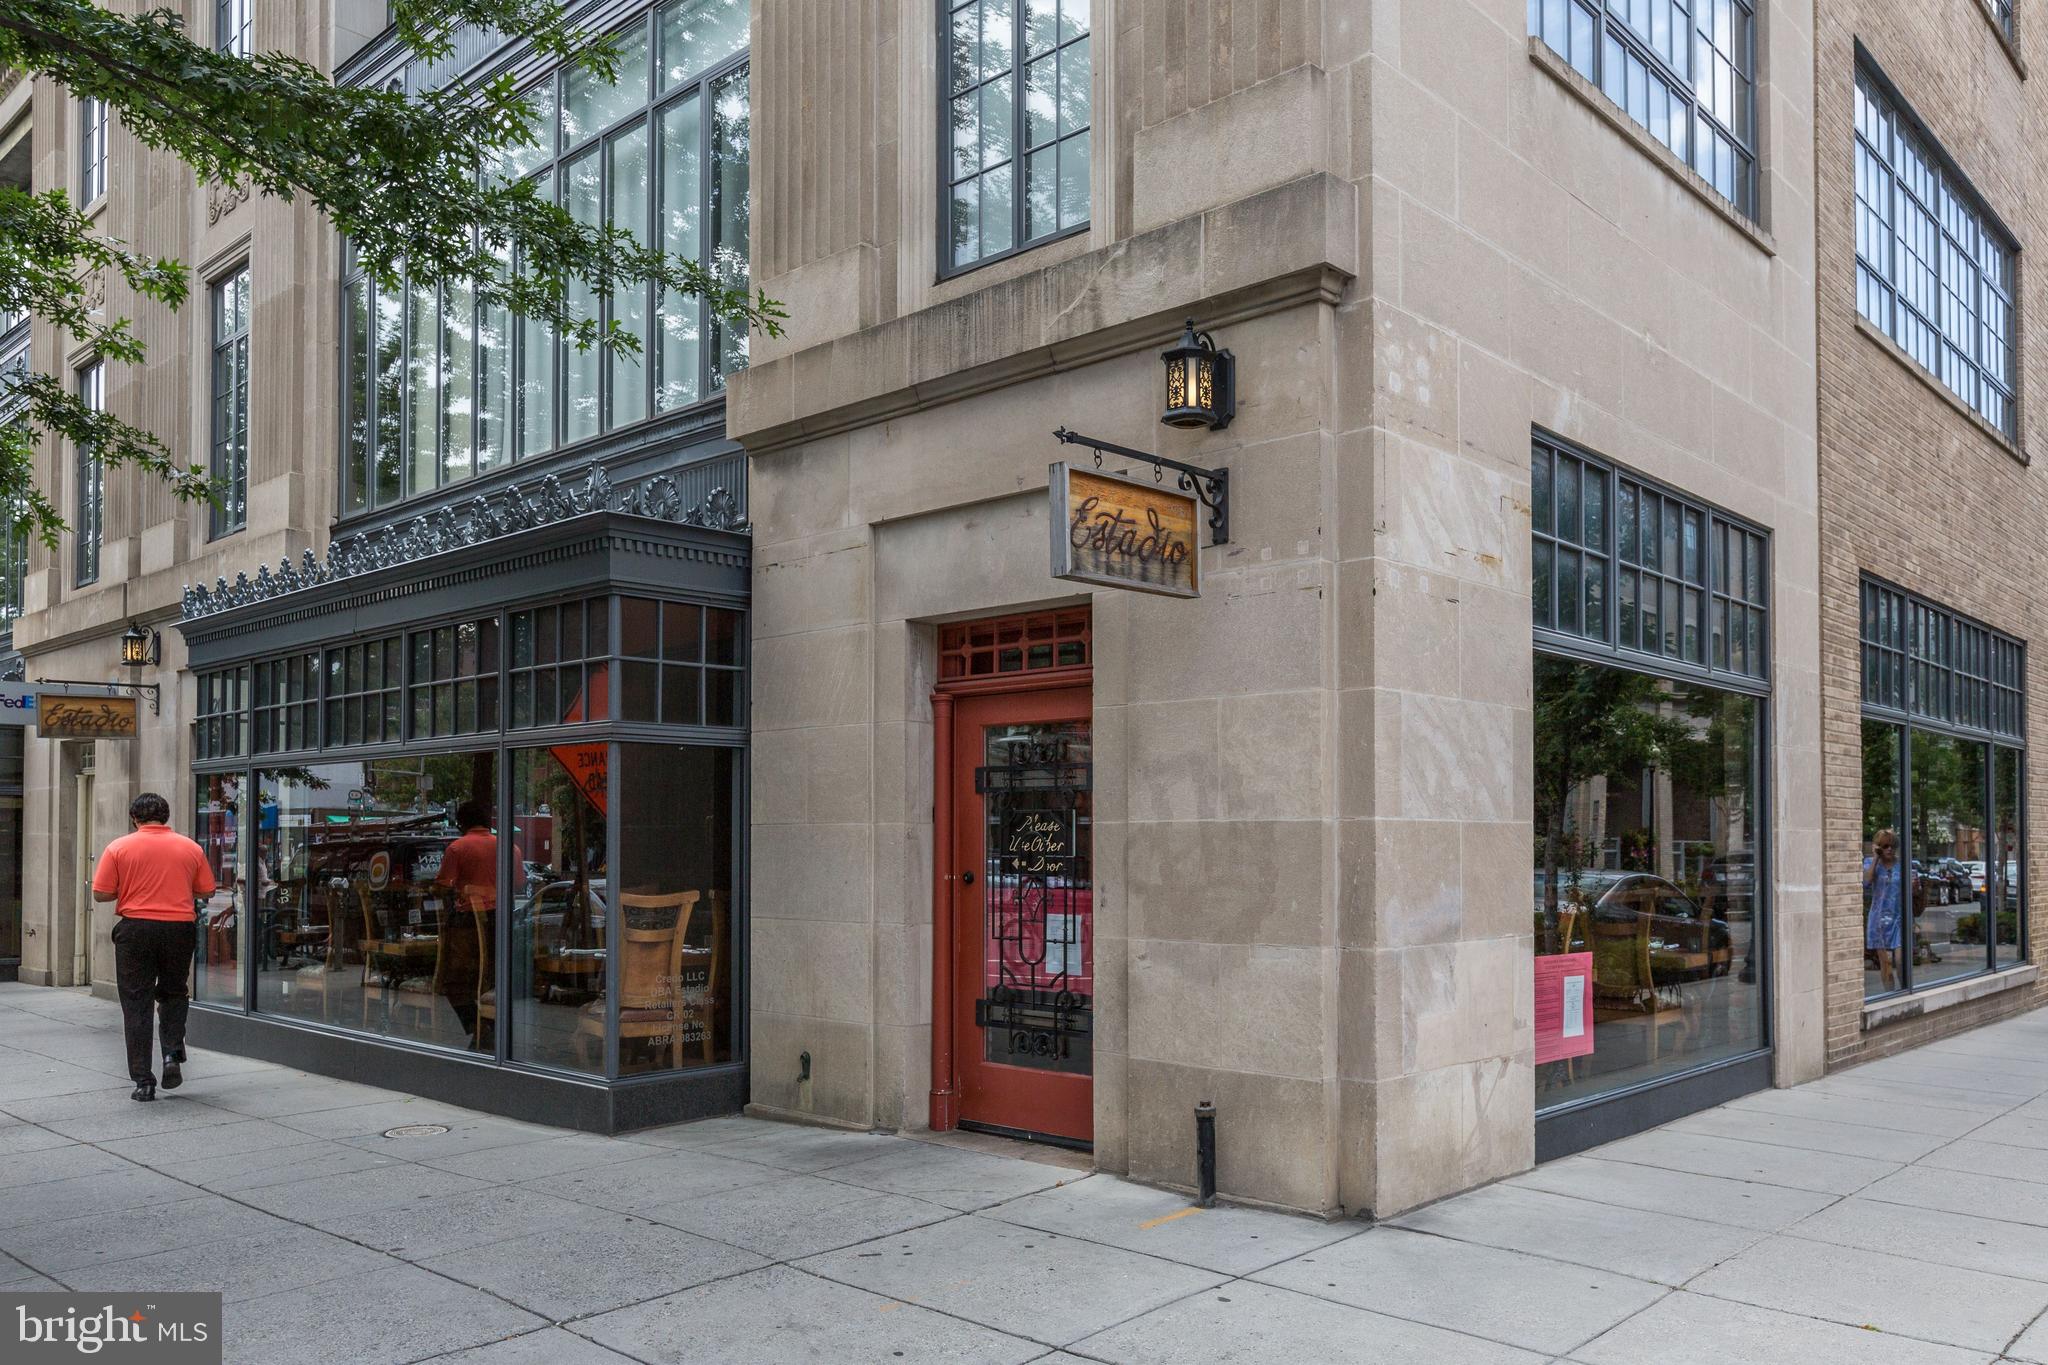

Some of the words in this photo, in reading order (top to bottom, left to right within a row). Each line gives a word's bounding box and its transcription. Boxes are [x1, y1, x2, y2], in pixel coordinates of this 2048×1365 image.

[1070, 496, 1188, 565] Estadio
[0, 694, 34, 709] FedE
[45, 703, 132, 728] Estadio
[1016, 814, 1061, 832] Please
[686, 971, 705, 982] LLC
[675, 984, 709, 994] Estadio
[684, 1009, 695, 1019] 02
[648, 1034, 676, 1046] ABRA
